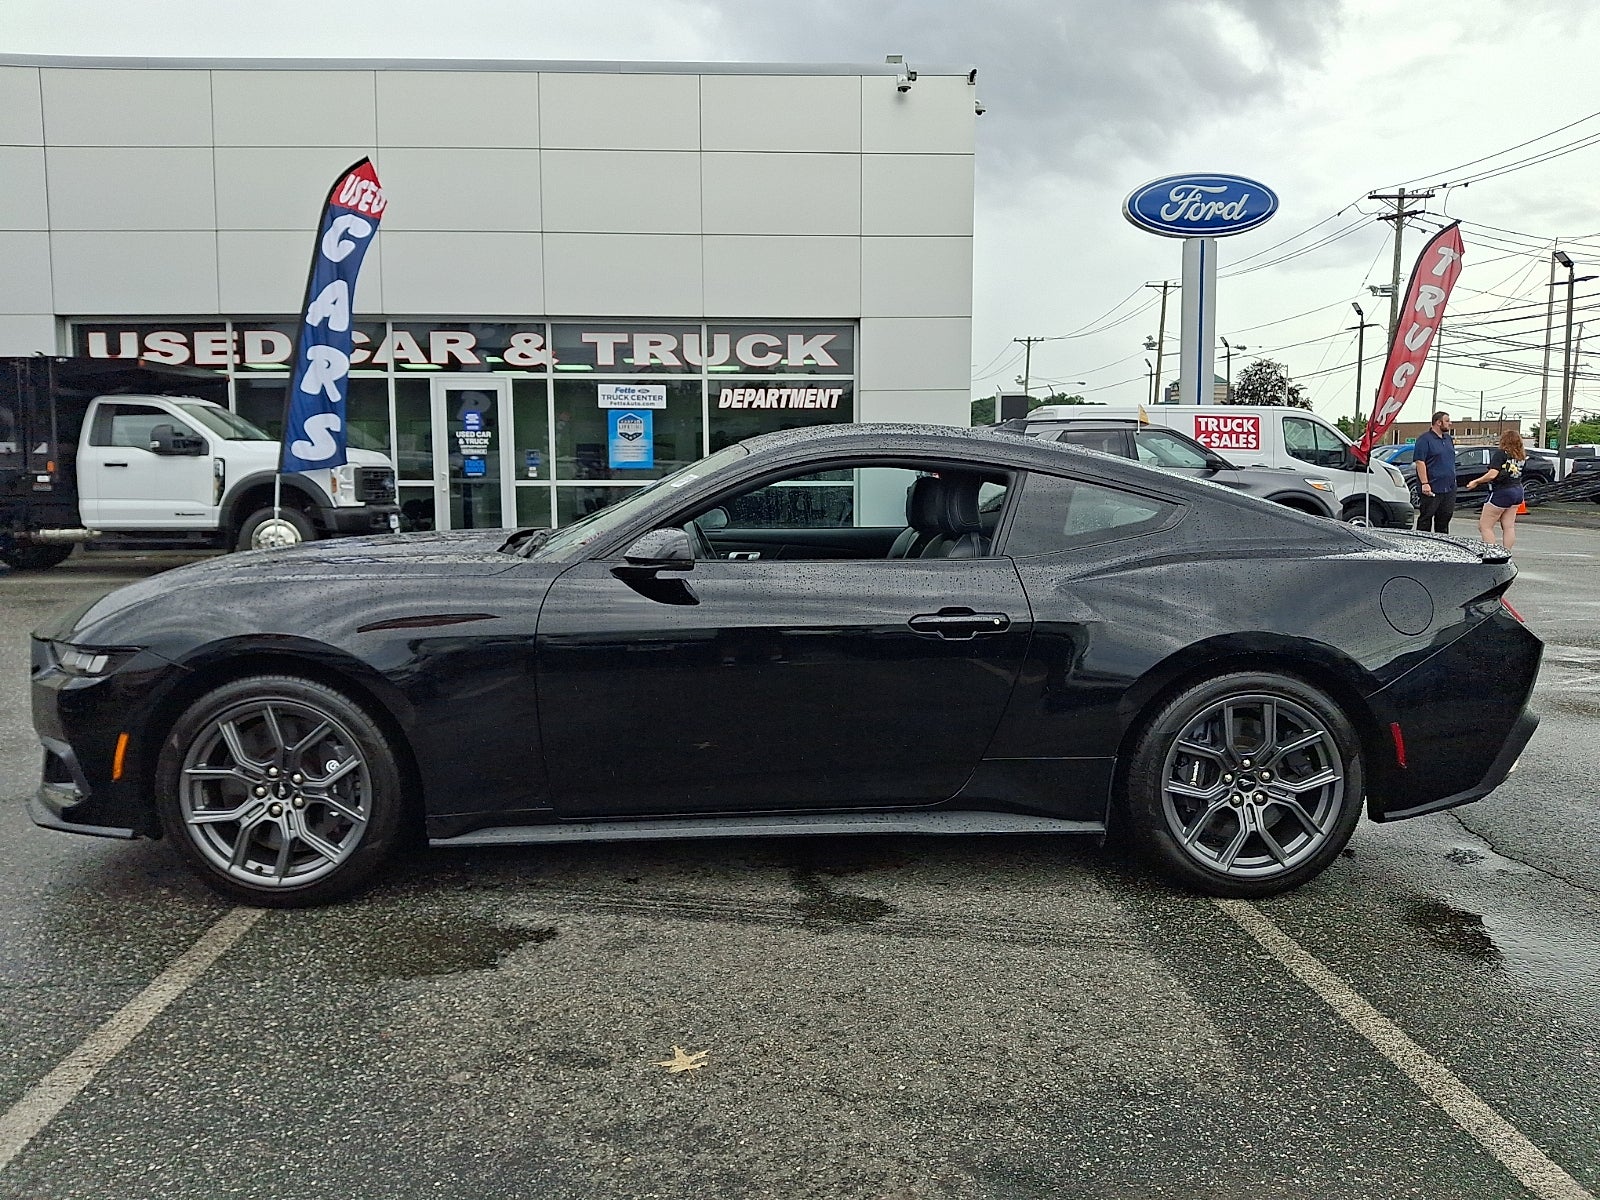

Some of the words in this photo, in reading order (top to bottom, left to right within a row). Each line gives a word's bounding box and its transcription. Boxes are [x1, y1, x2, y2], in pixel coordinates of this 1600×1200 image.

[339, 173, 387, 214] USED
[1160, 184, 1250, 222] Ford
[88, 330, 293, 366] USED
[502, 331, 560, 366] &
[581, 333, 839, 367] TRUCK
[290, 213, 372, 461] CARS
[1376, 246, 1460, 425] TRUCK
[630, 394, 664, 402] CENTER
[718, 388, 843, 409] DEPARTMENT
[1197, 417, 1257, 433] TRUCK
[1210, 432, 1257, 448] SALES
